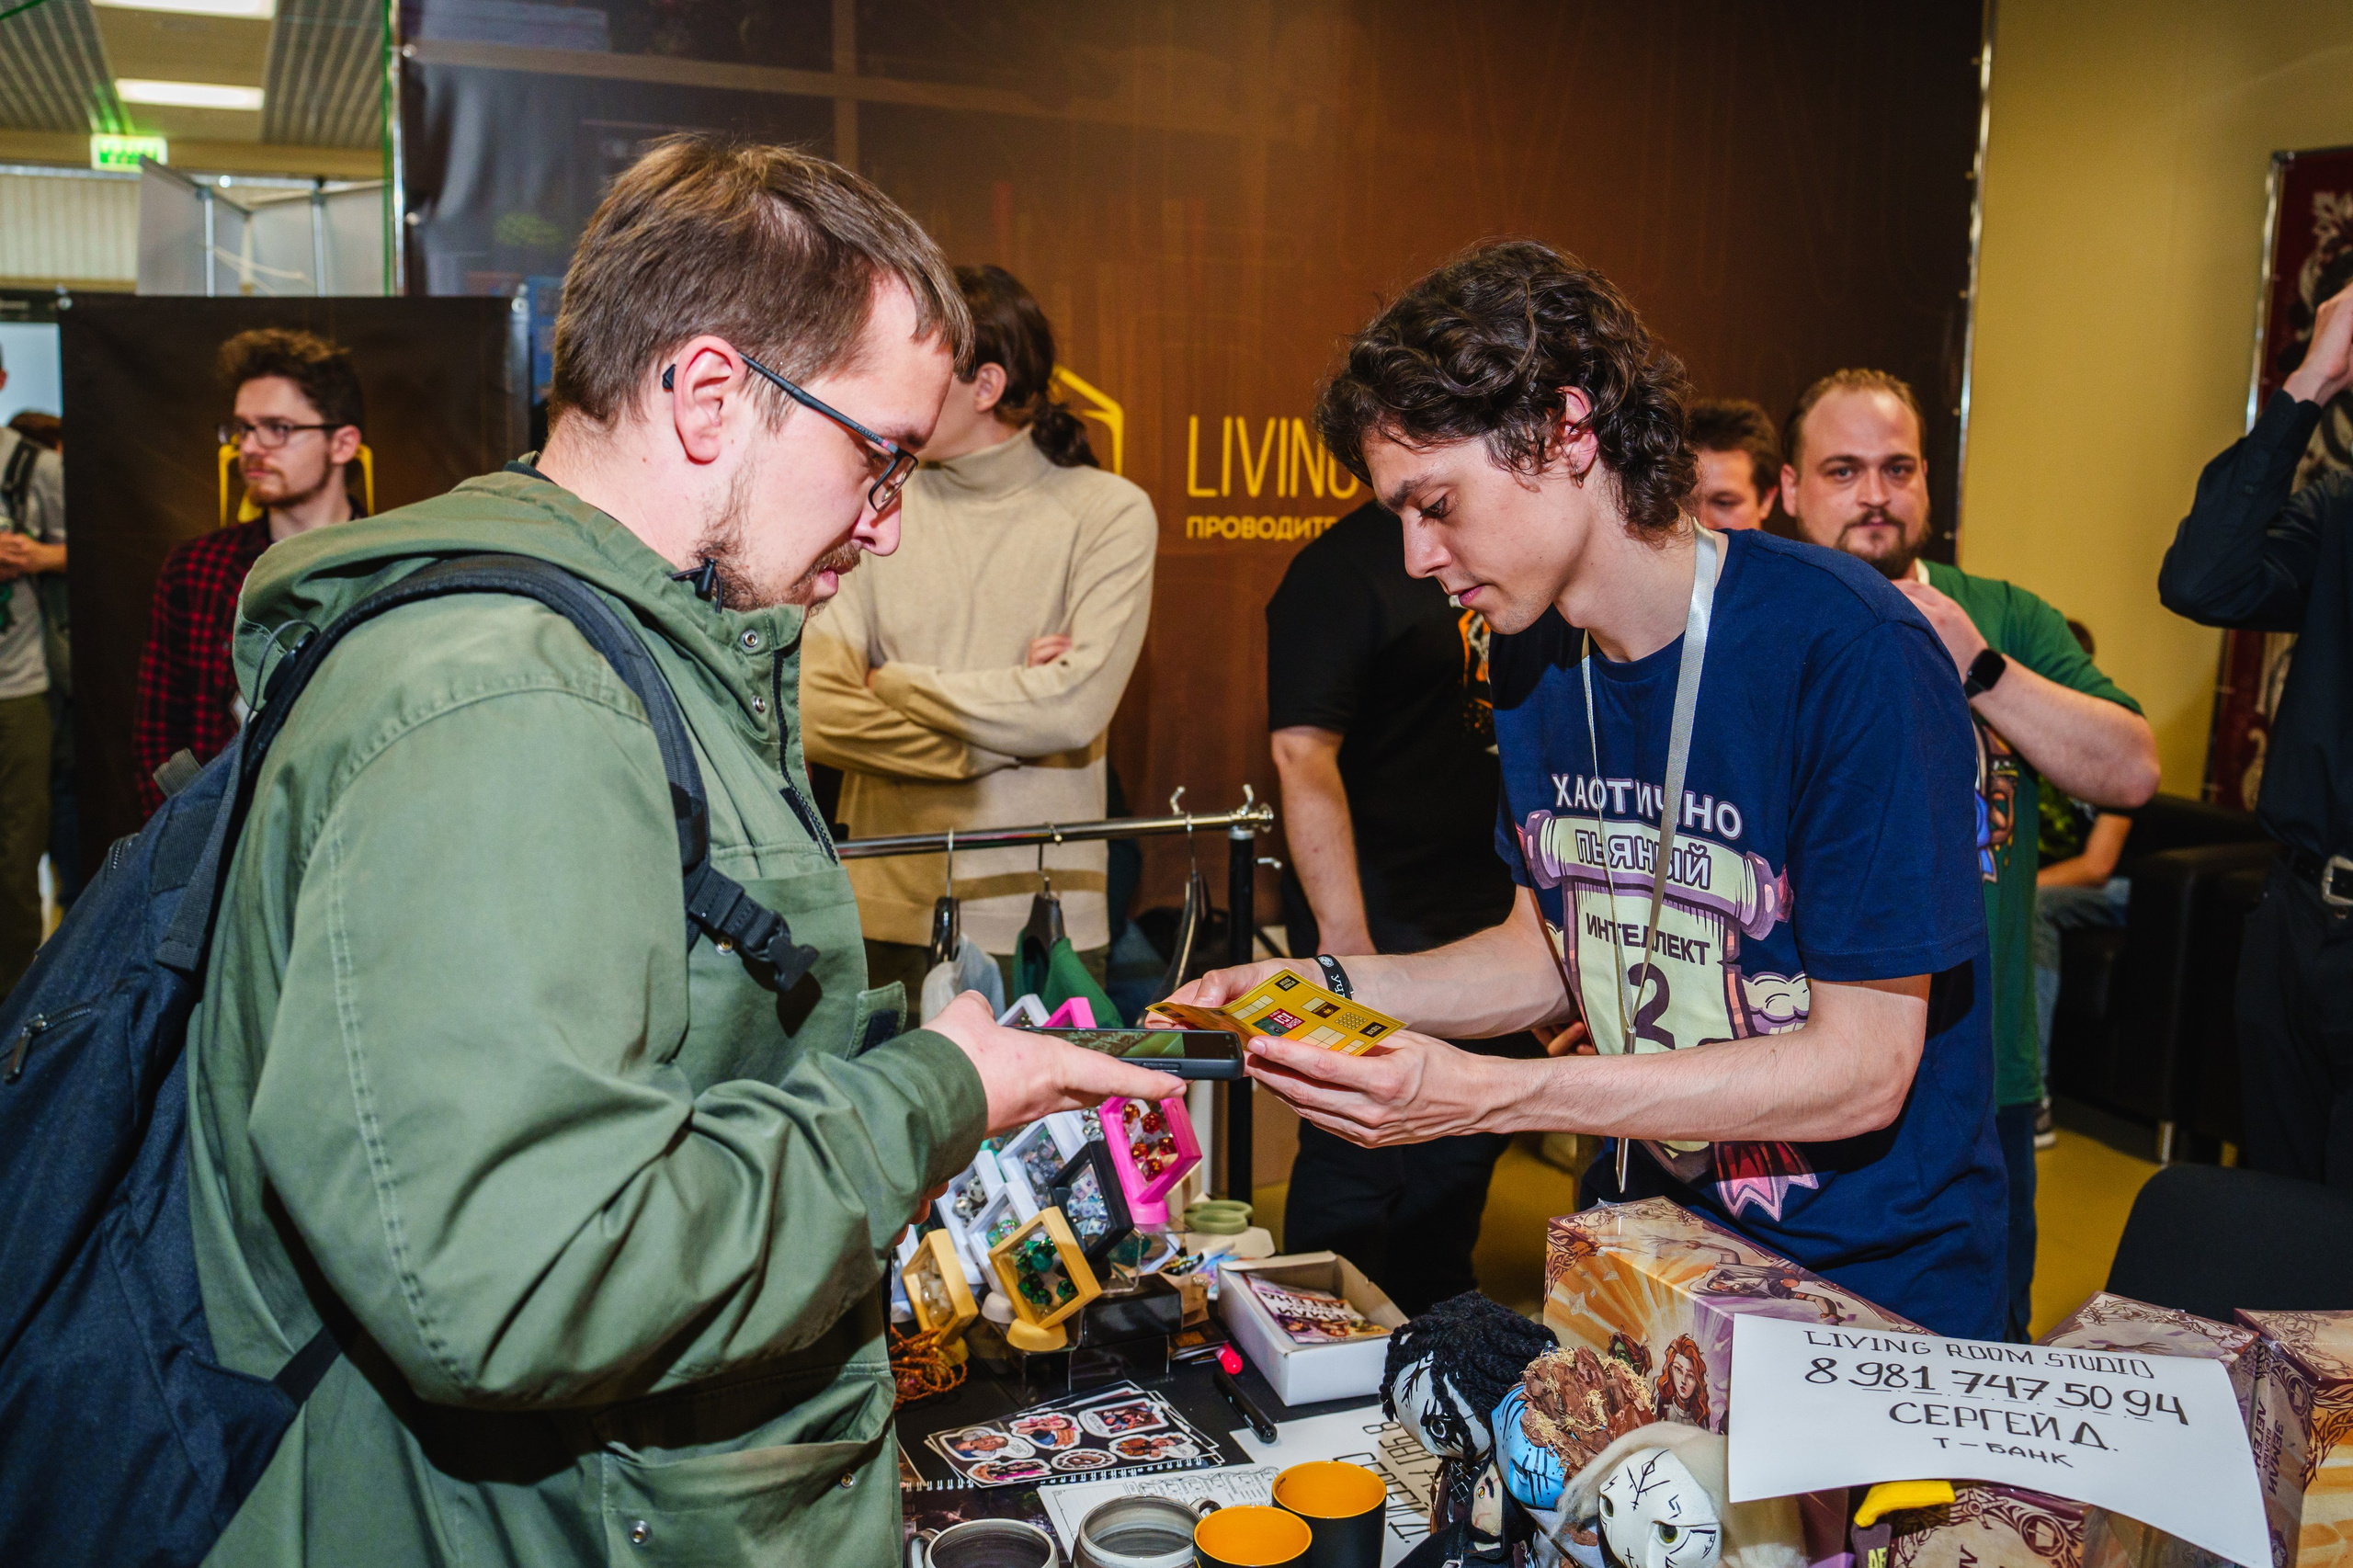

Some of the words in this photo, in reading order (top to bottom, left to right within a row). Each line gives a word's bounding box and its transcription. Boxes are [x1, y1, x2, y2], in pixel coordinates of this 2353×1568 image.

[1575, 829, 1711, 891] ПЬЯНЫЙ
[1586, 913, 1711, 966] ИНТЕЛЛЕКТ
[1802, 1330, 1931, 1355] LIVING
[1946, 1343, 2034, 1365] ROOM
[2044, 1352, 2154, 1379] STUDIO
[1804, 1357, 1838, 1384] 8
[1847, 1361, 1936, 1391] 981
[1951, 1369, 2051, 1401] 747
[2054, 1381, 2113, 1410] 50
[2122, 1389, 2189, 1426] 94
[1362, 1421, 1402, 1435] 8
[1889, 1402, 2062, 1441] СЕРГЕЙ
[2252, 1396, 2268, 1479] ЛЕГЕН
[2267, 1418, 2284, 1496] ЗЕМЛИ
